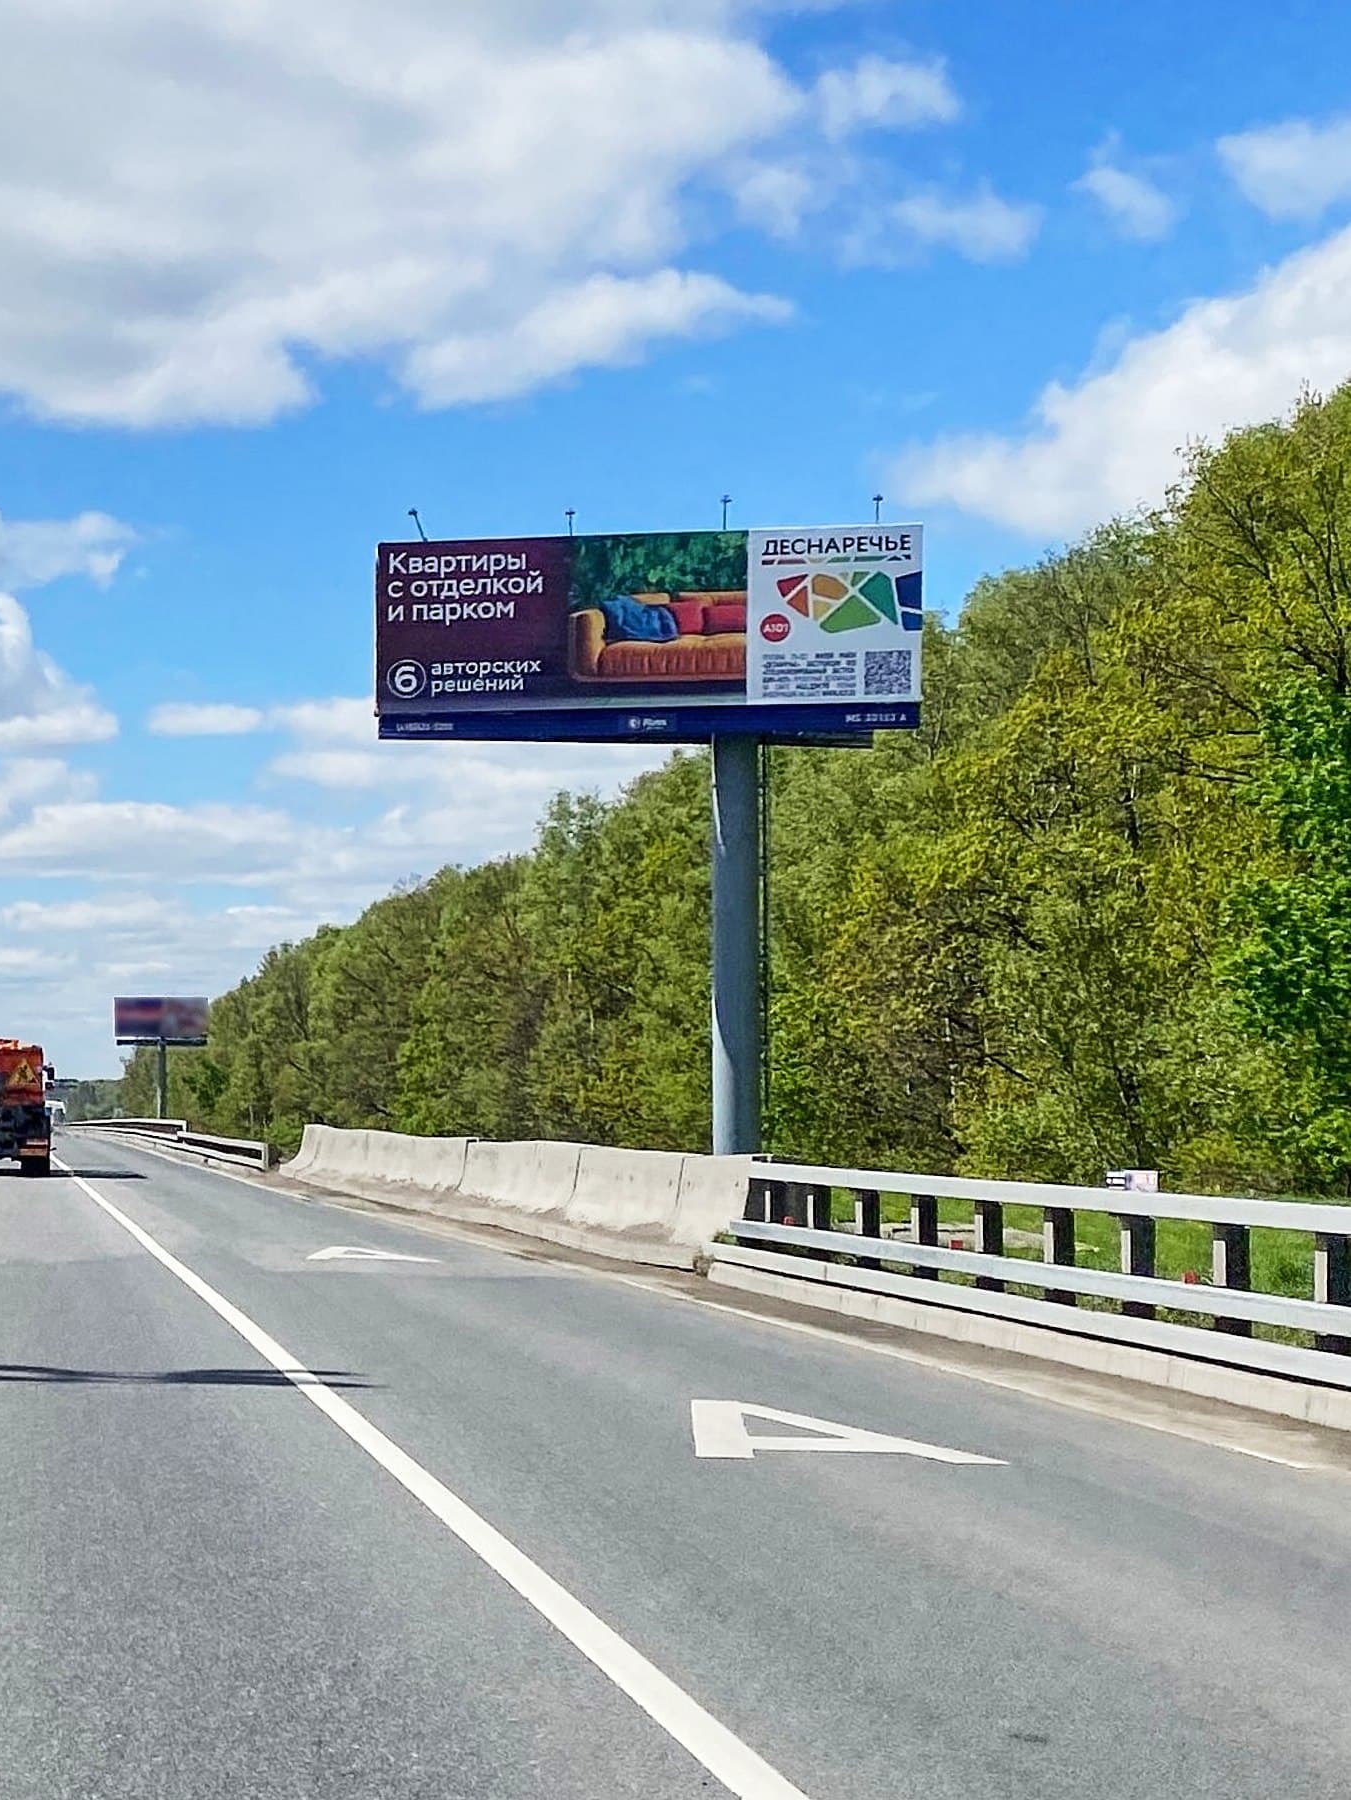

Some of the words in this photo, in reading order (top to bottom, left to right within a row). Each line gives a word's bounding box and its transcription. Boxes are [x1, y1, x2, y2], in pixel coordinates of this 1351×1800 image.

[761, 534, 912, 556] ДЕСНАРЕЧЬЕ
[388, 552, 527, 578] Квартиры
[387, 581, 404, 598] с
[410, 570, 544, 600] отделкой
[387, 605, 405, 622] и
[412, 601, 516, 626] парком
[394, 665, 418, 693] 6
[431, 660, 542, 678] авторских
[431, 674, 525, 697] решений
